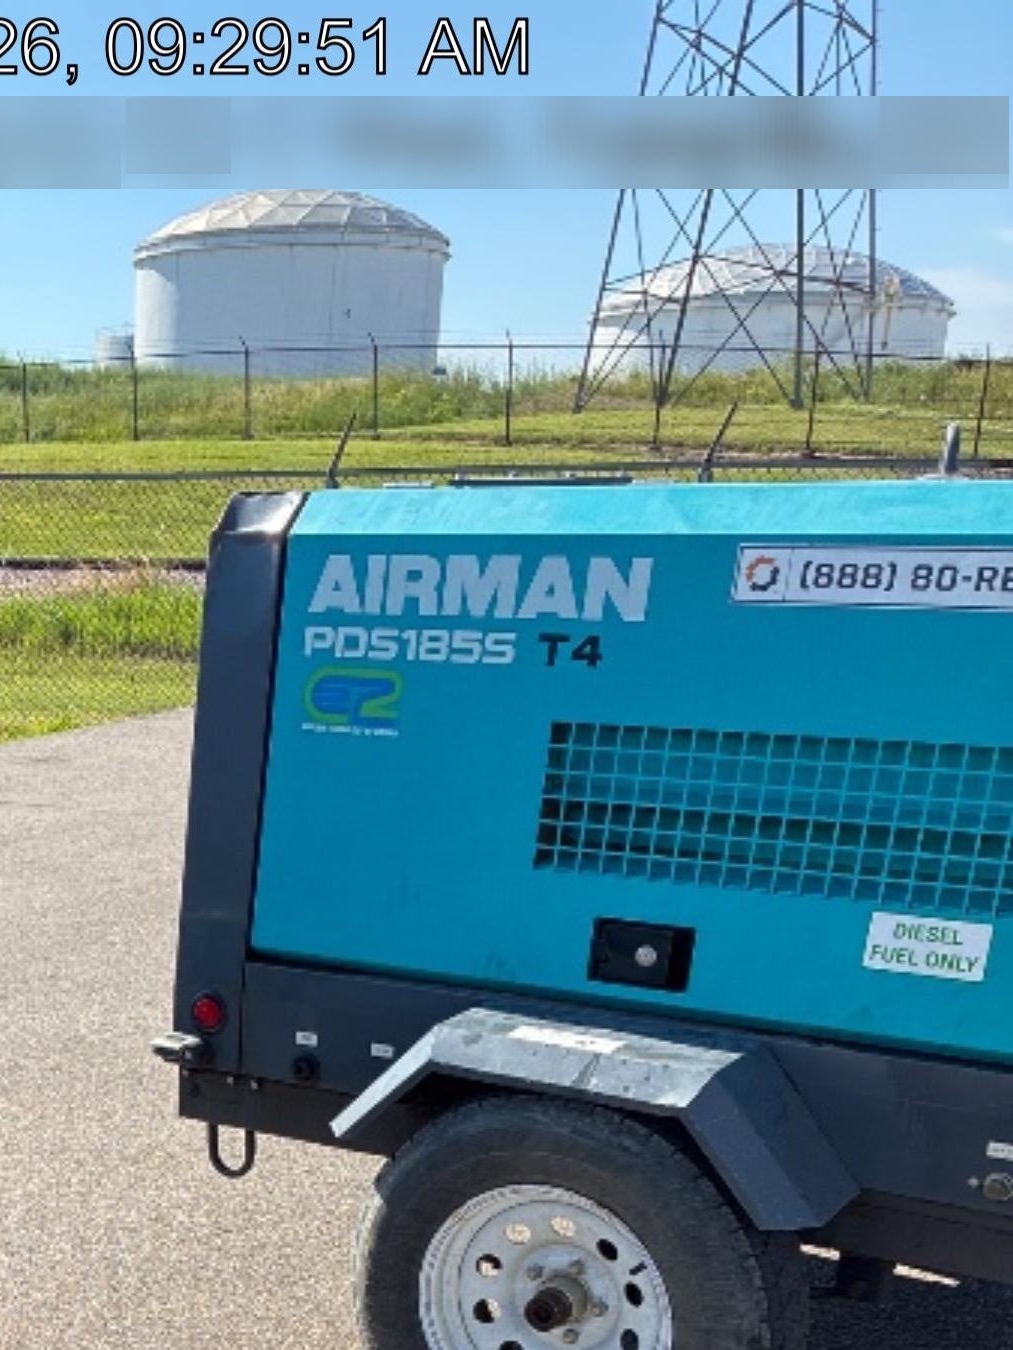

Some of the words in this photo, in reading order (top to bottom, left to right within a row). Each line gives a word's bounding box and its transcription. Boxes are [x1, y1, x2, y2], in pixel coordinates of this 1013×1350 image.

[307, 553, 655, 622] AIRMAN
[799, 560, 898, 592] (888)
[303, 625, 517, 665] PDS185S
[539, 632, 603, 668] T4
[892, 922, 964, 946] DIESEL
[868, 944, 919, 968] FUEL
[924, 949, 981, 974] ONLY
